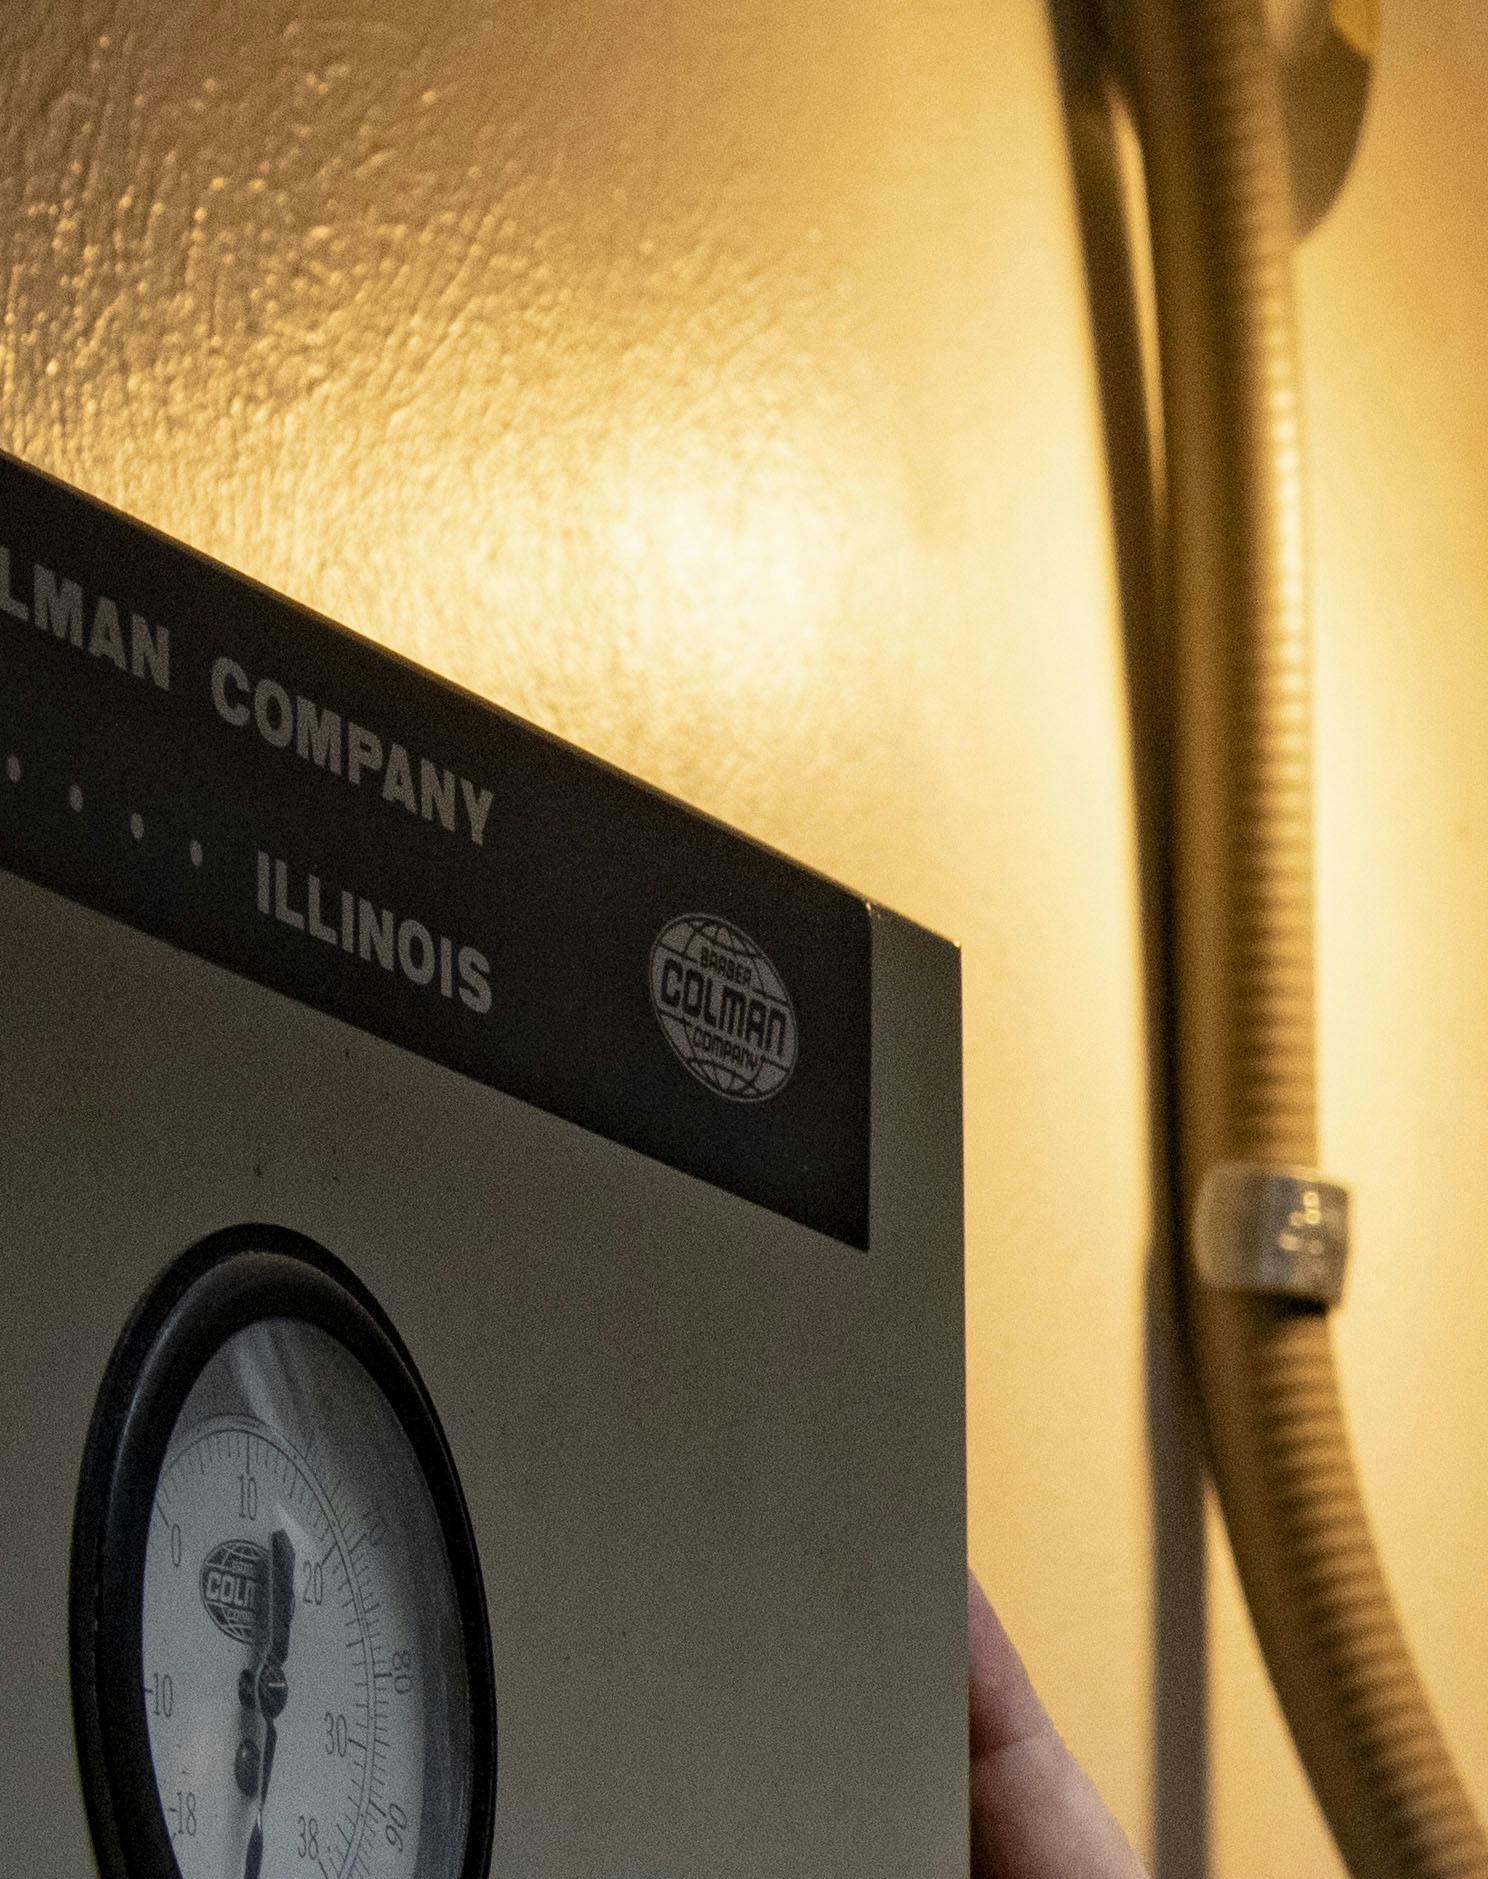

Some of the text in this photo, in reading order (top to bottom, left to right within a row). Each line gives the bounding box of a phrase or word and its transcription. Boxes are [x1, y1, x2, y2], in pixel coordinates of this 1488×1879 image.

[209, 658, 495, 846] COMPANY
[257, 851, 493, 1014] ILLINOIS
[700, 946, 752, 986] BARBER
[661, 958, 787, 1058] COLMAN
[693, 1027, 760, 1072] COMPANY
[238, 1474, 258, 1522] 10
[171, 1523, 181, 1568] 0
[302, 1560, 323, 1606] 20
[391, 1650, 414, 1696] 80
[324, 1711, 348, 1758] 30
[297, 1815, 319, 1861] 38
[385, 1802, 408, 1853] 90
